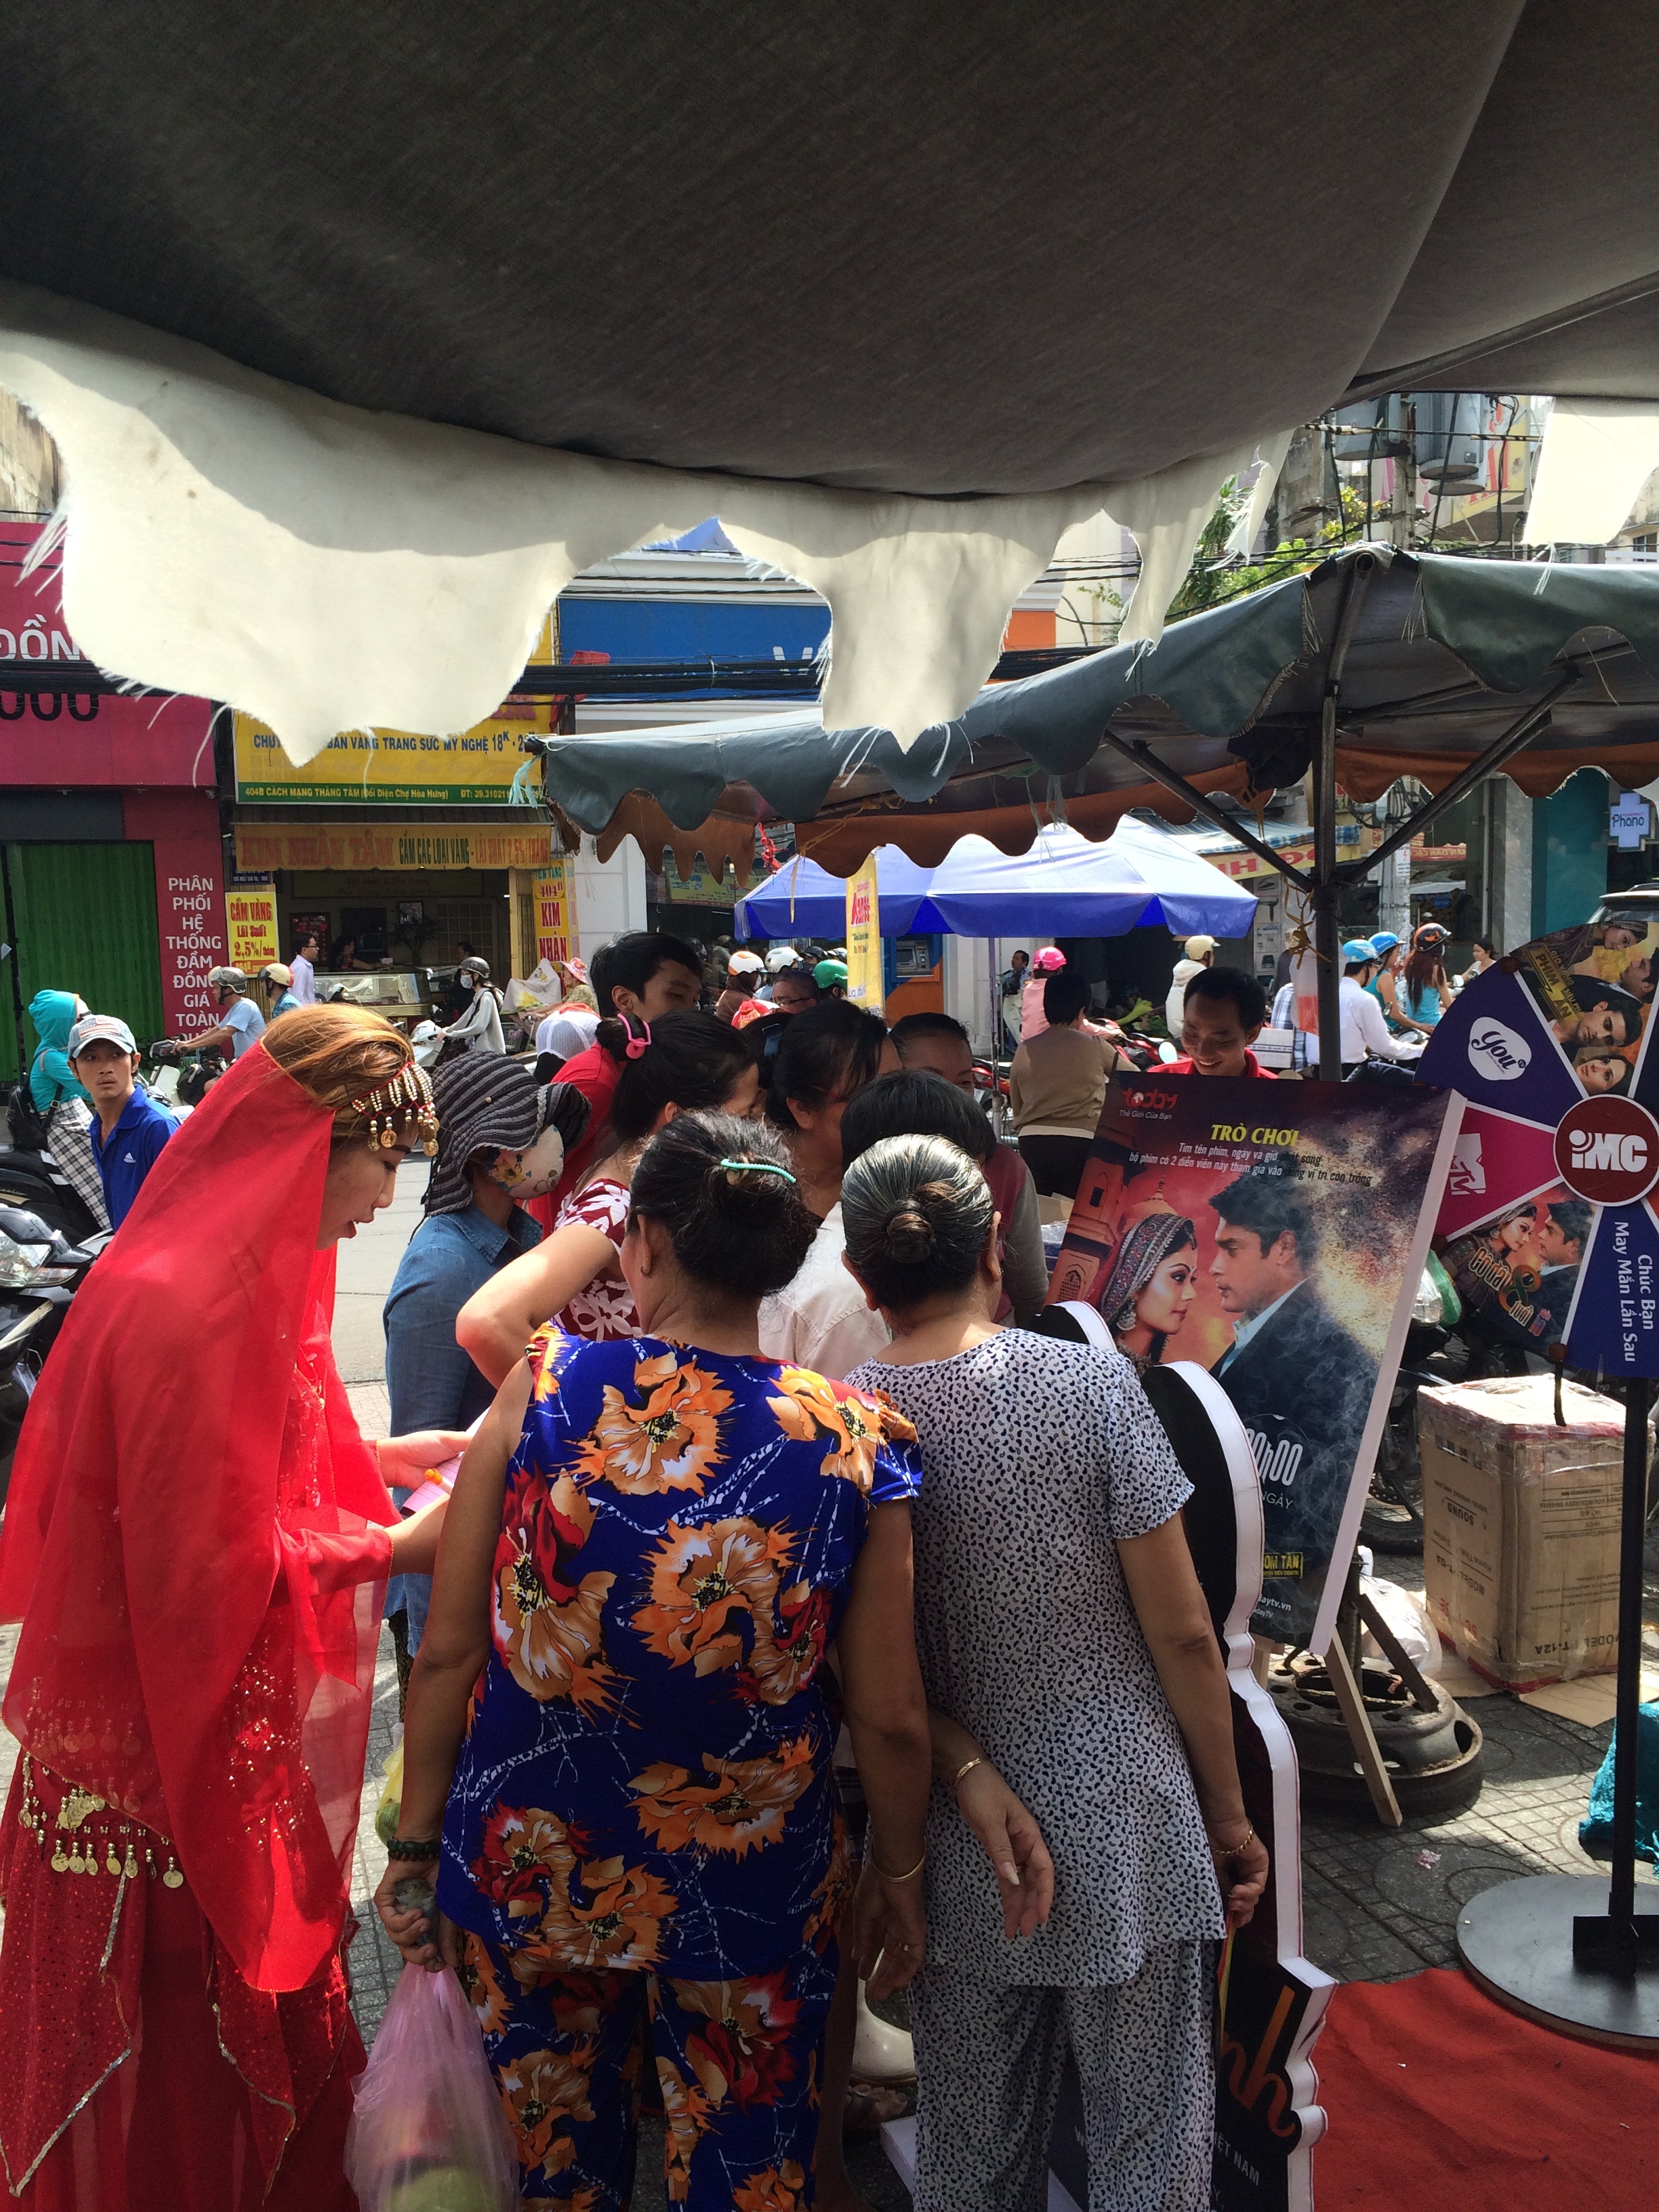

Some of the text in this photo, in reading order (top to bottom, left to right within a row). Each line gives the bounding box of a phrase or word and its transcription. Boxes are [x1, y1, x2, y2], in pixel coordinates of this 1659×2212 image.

[0, 614, 85, 660] ĐỒN
[350, 733, 379, 750] VÀNG
[383, 737, 416, 750] TRANG
[420, 735, 439, 751] SỨC
[462, 736, 489, 754] NGHỆ
[245, 787, 264, 796] 404B
[266, 785, 288, 796] CÁCH
[289, 787, 313, 799] MẠNG
[314, 785, 342, 797] THÁNG
[343, 786, 360, 797] TÁM
[377, 788, 394, 800] Diện
[1612, 814, 1644, 827] Phano
[241, 837, 283, 866] KIM
[286, 828, 344, 866] NHÂN
[349, 828, 394, 866] TÂM
[417, 833, 431, 864] CÁC
[432, 838, 449, 869] LOẠI
[450, 833, 470, 864] VÀNG
[169, 875, 213, 891] PHÂN
[173, 893, 211, 910] PHỐI
[230, 897, 272, 921] CẦM VÀNG
[182, 914, 203, 932] HỆ
[541, 901, 560, 926] KIM
[166, 931, 221, 949] THỐNG
[539, 930, 567, 962] NHÂN
[177, 951, 212, 968] ĐẦM
[1535, 954, 1560, 987] PHIM
[184, 991, 210, 1007] GIÁ
[176, 1011, 220, 1027] TOÀN
[1122, 1087, 1179, 1109] today
[1120, 1109, 1172, 1121] Thế Giới Của Bạn
[1210, 1123, 1299, 1147] TRÒ CHƠI
[1129, 1151, 1138, 1162] bộ
[1139, 1152, 1158, 1165] phim
[1160, 1154, 1169, 1165] có
[1170, 1155, 1176, 1166] 2
[1196, 1157, 1212, 1168] viên
[1214, 1160, 1228, 1173] này
[1230, 1161, 1251, 1173] tham
[1252, 1164, 1266, 1176] gia
[1267, 1166, 1283, 1176] vào
[1195, 1144, 1207, 1155] tên
[1208, 1145, 1229, 1158] phim,
[1231, 1147, 1252, 1161] ngày
[1253, 1149, 1263, 1160] và
[1300, 1153, 1322, 1167] sóng
[1613, 1221, 1638, 1362] May Mắn Lần Sau
[1637, 1254, 1656, 1330] Chúc Bạn
[1447, 1502, 1474, 1525] SOUND
[1264, 1555, 1278, 1569] OM
[1534, 1641, 1570, 1655] T-12A
[1214, 2131, 1260, 2186] IỆT NAM
